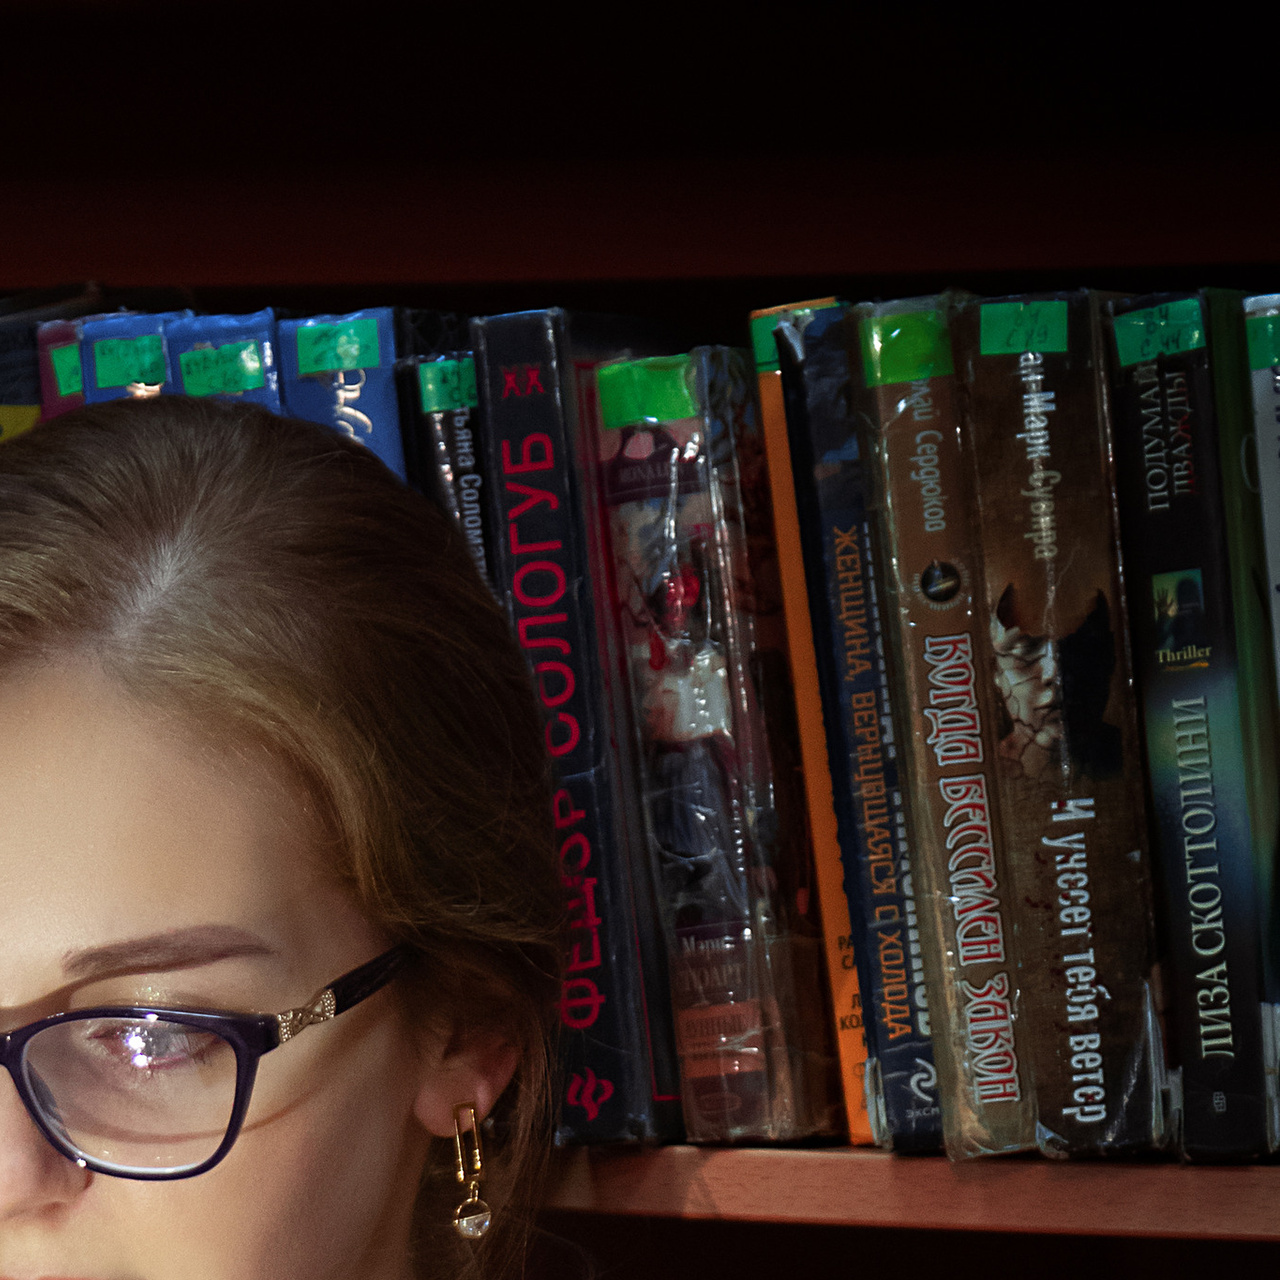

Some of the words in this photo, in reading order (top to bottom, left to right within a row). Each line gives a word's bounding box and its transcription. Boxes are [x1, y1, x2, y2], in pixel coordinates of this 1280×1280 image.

[1016, 351, 1057, 460] ан-Марк
[1164, 371, 1196, 495] ДВАЖДЫ
[910, 429, 946, 532] Сердюков
[831, 524, 874, 682] ЖЕНЩИНА,
[1157, 646, 1212, 663] Thriller
[924, 633, 984, 765] КОГДА
[850, 692, 895, 895] ВЕРНУВШАЯСЯ
[1051, 797, 1097, 822] И
[1170, 697, 1227, 957] СКОТТОЛИНИ
[939, 774, 1006, 965] БЕССИЛЕН
[878, 929, 914, 1040] ХОЛОДА
[960, 973, 1021, 1104] ЗАКОН
[1062, 947, 1112, 1022] тебя
[1195, 960, 1236, 1059] ЛИЗА
[1061, 1033, 1108, 1123] ветер
